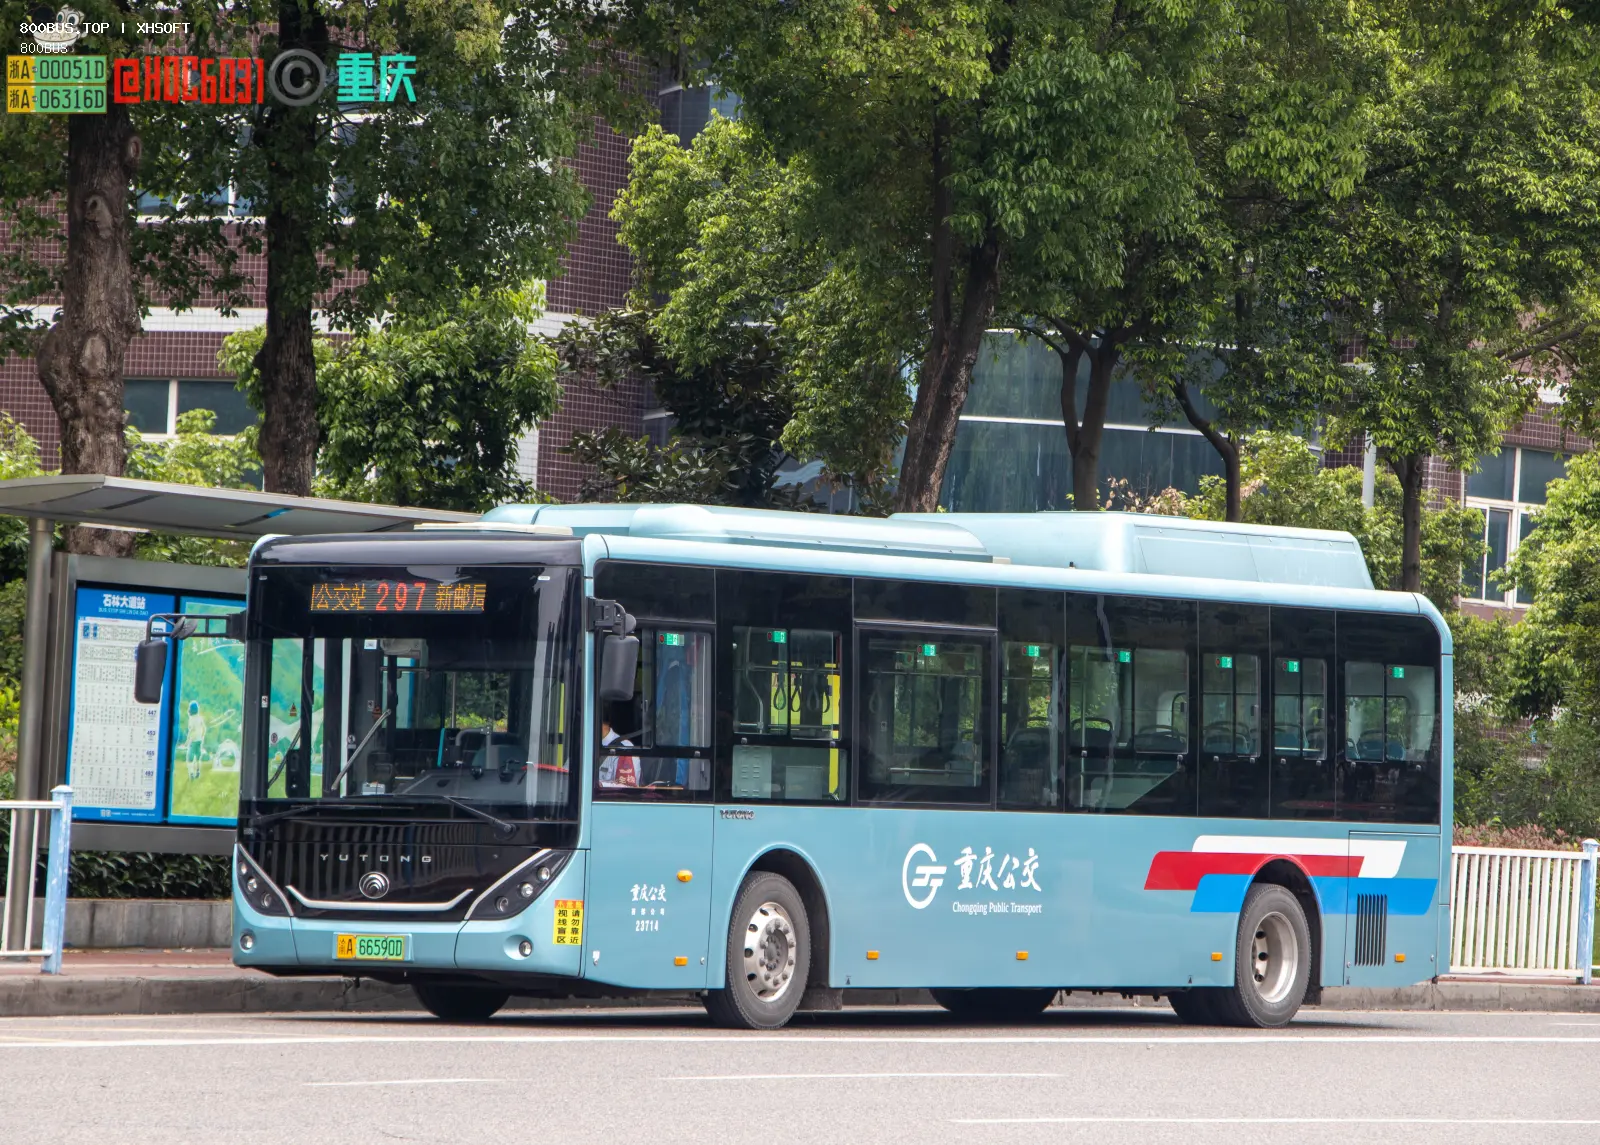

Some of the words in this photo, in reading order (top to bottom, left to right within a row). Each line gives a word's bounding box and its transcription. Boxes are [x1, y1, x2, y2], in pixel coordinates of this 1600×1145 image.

[103, 594, 146, 610] 石林大道站
[375, 582, 426, 611] 297
[435, 583, 487, 611] 新邮局
[320, 854, 432, 863] YUTONG
[954, 846, 1042, 892] 重庆公交
[630, 883, 667, 902] 重庆公交
[952, 902, 988, 915] Chongqing
[989, 902, 1009, 913] Public
[1010, 903, 1042, 916] Transport
[635, 919, 659, 931] 23714
